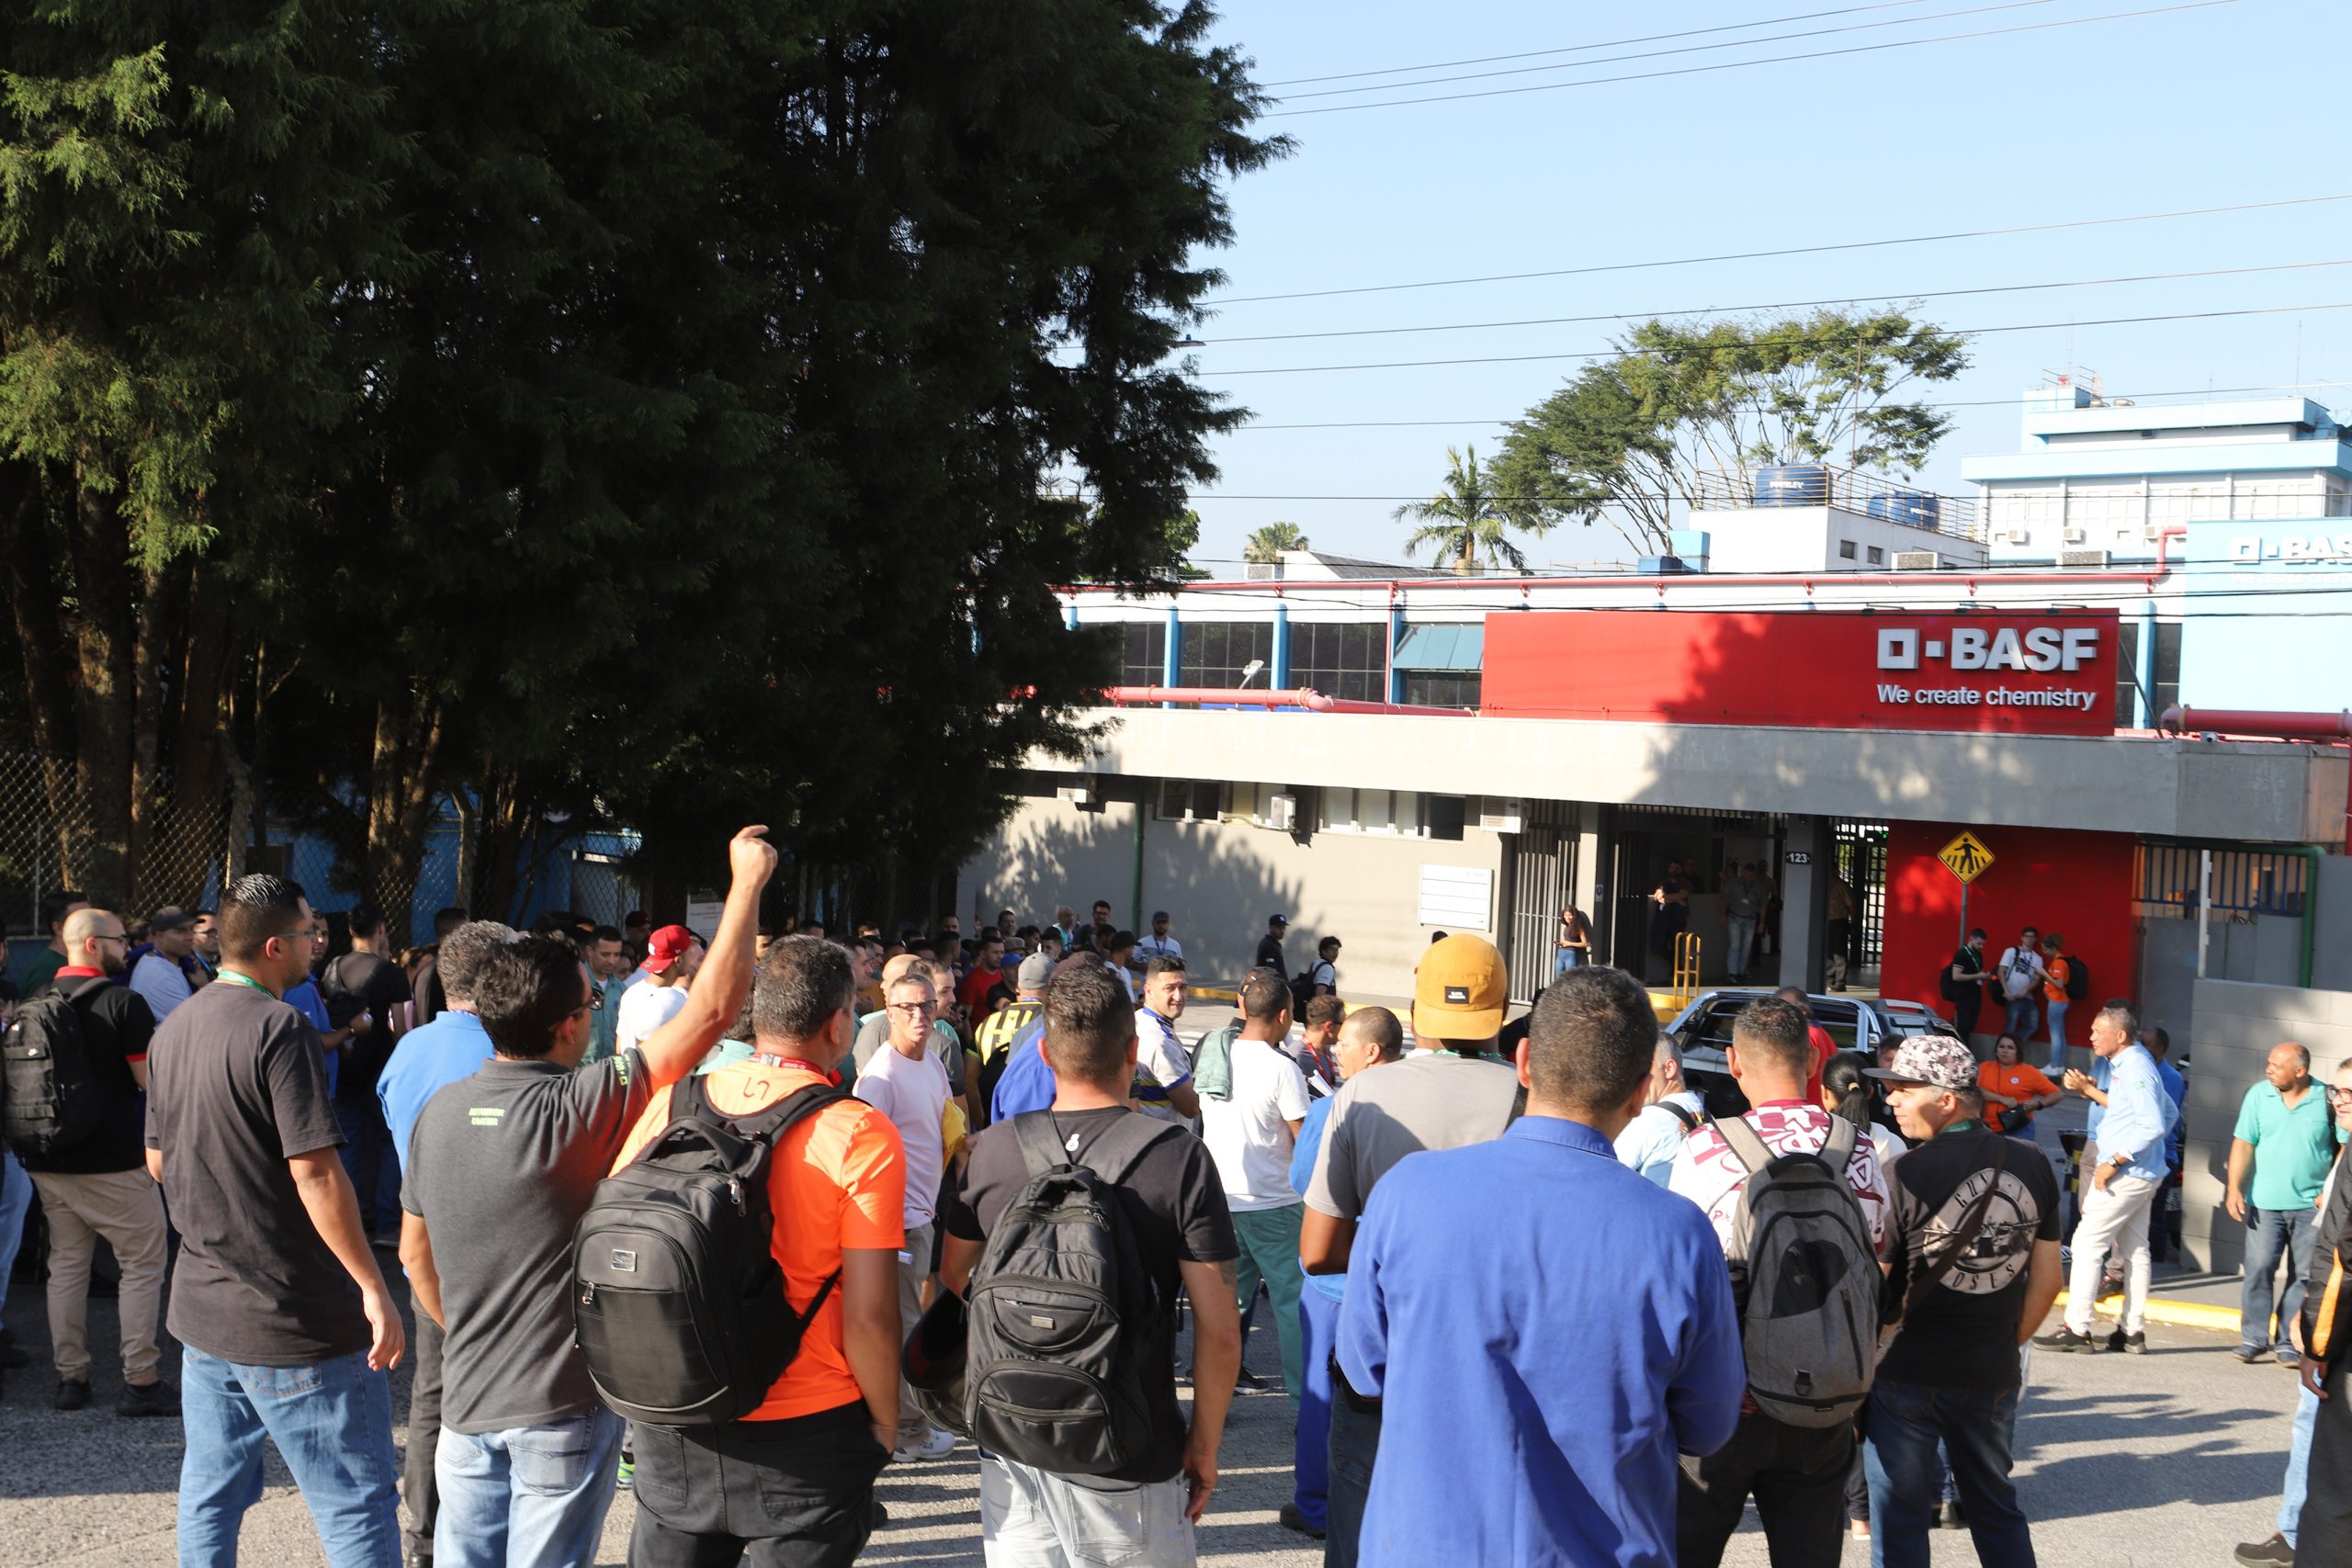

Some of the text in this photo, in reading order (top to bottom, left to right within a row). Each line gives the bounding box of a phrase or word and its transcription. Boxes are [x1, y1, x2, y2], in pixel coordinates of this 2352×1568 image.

[1951, 626, 2099, 671] BASF
[1877, 684, 2097, 712] We create chemistry
